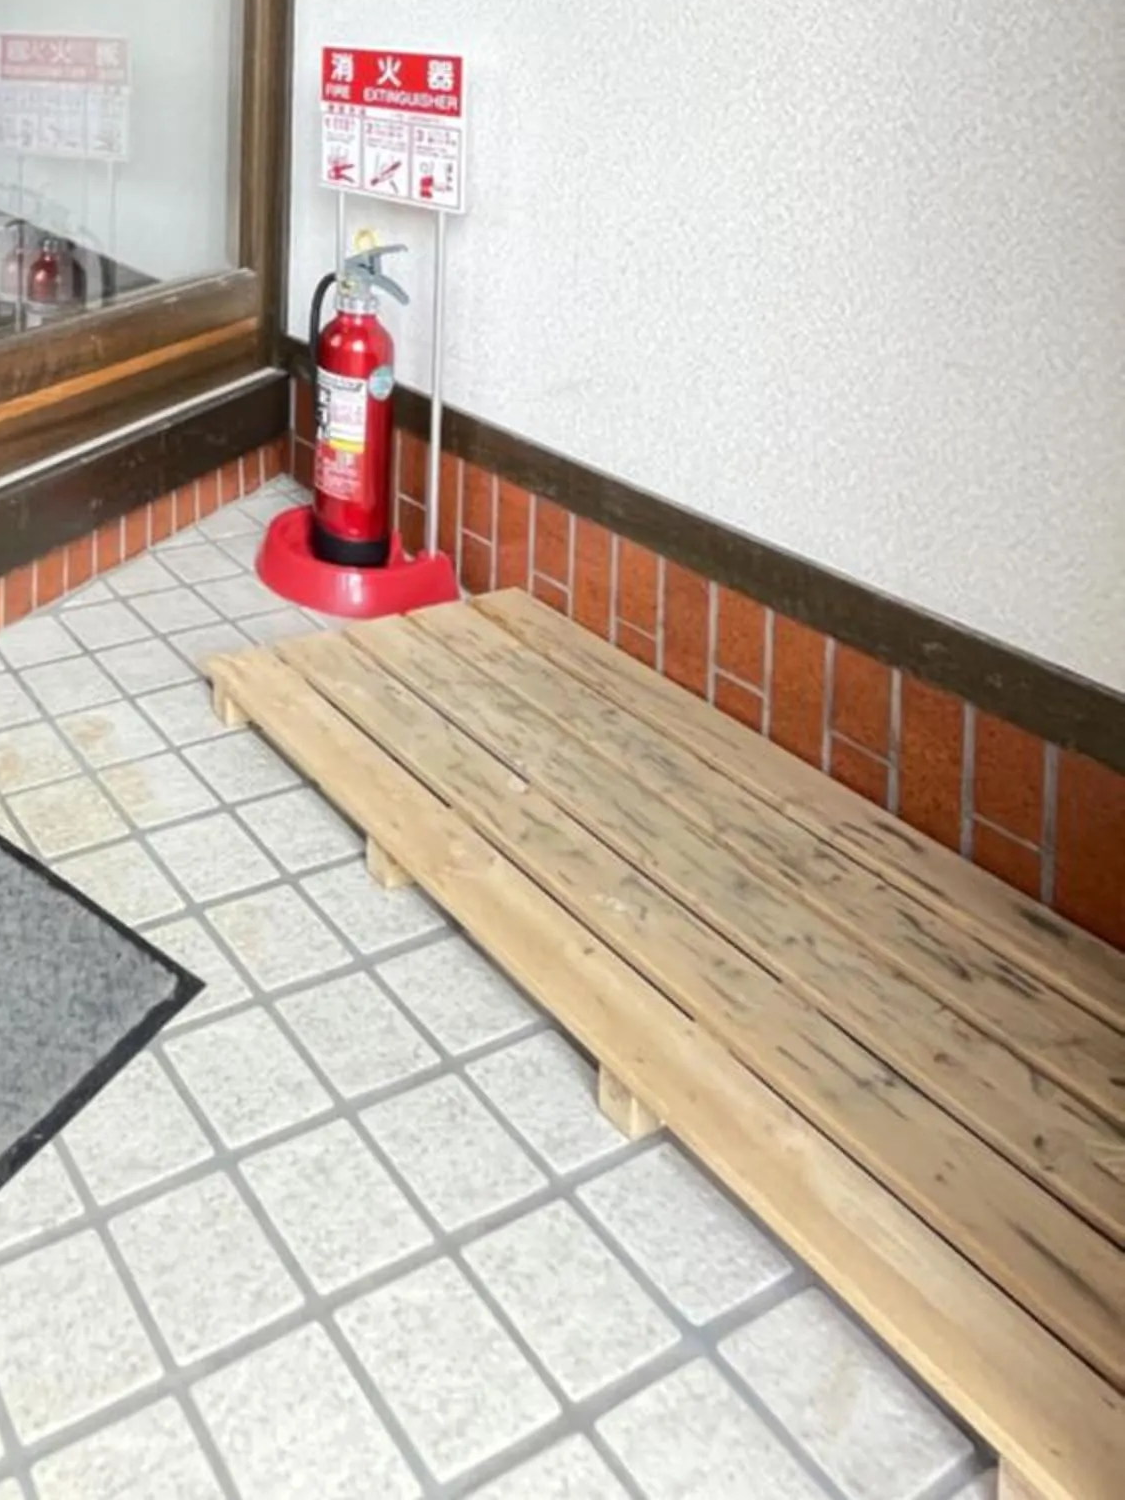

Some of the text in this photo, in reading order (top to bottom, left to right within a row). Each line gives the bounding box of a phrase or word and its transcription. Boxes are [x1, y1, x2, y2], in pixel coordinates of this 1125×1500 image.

[331, 52, 454, 91] 消火器
[325, 83, 351, 100] FIRE
[363, 87, 458, 111] EXTINGUISHER
